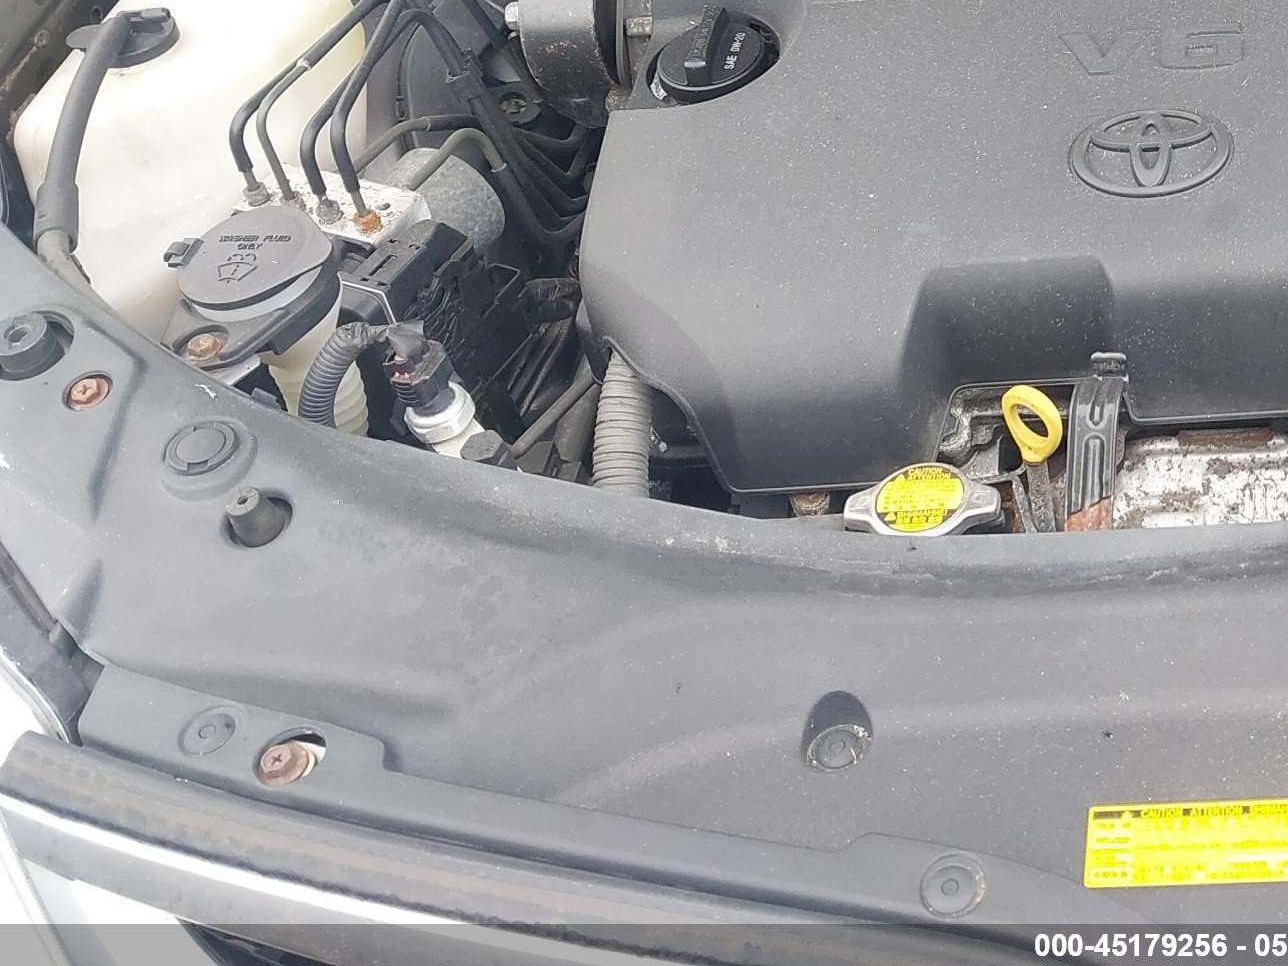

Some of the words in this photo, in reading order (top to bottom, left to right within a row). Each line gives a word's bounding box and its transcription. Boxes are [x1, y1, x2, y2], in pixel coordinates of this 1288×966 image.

[1058, 22, 1245, 76] V6
[724, 55, 737, 69] SAE
[219, 235, 260, 243] WASHER
[263, 235, 292, 243] FLUID
[237, 243, 263, 251] ONLY
[908, 467, 943, 475] CAUTION
[907, 473, 951, 481] ATTENTION
[1140, 807, 1184, 819] CAUTION
[1191, 805, 1245, 817] ATTENTION
